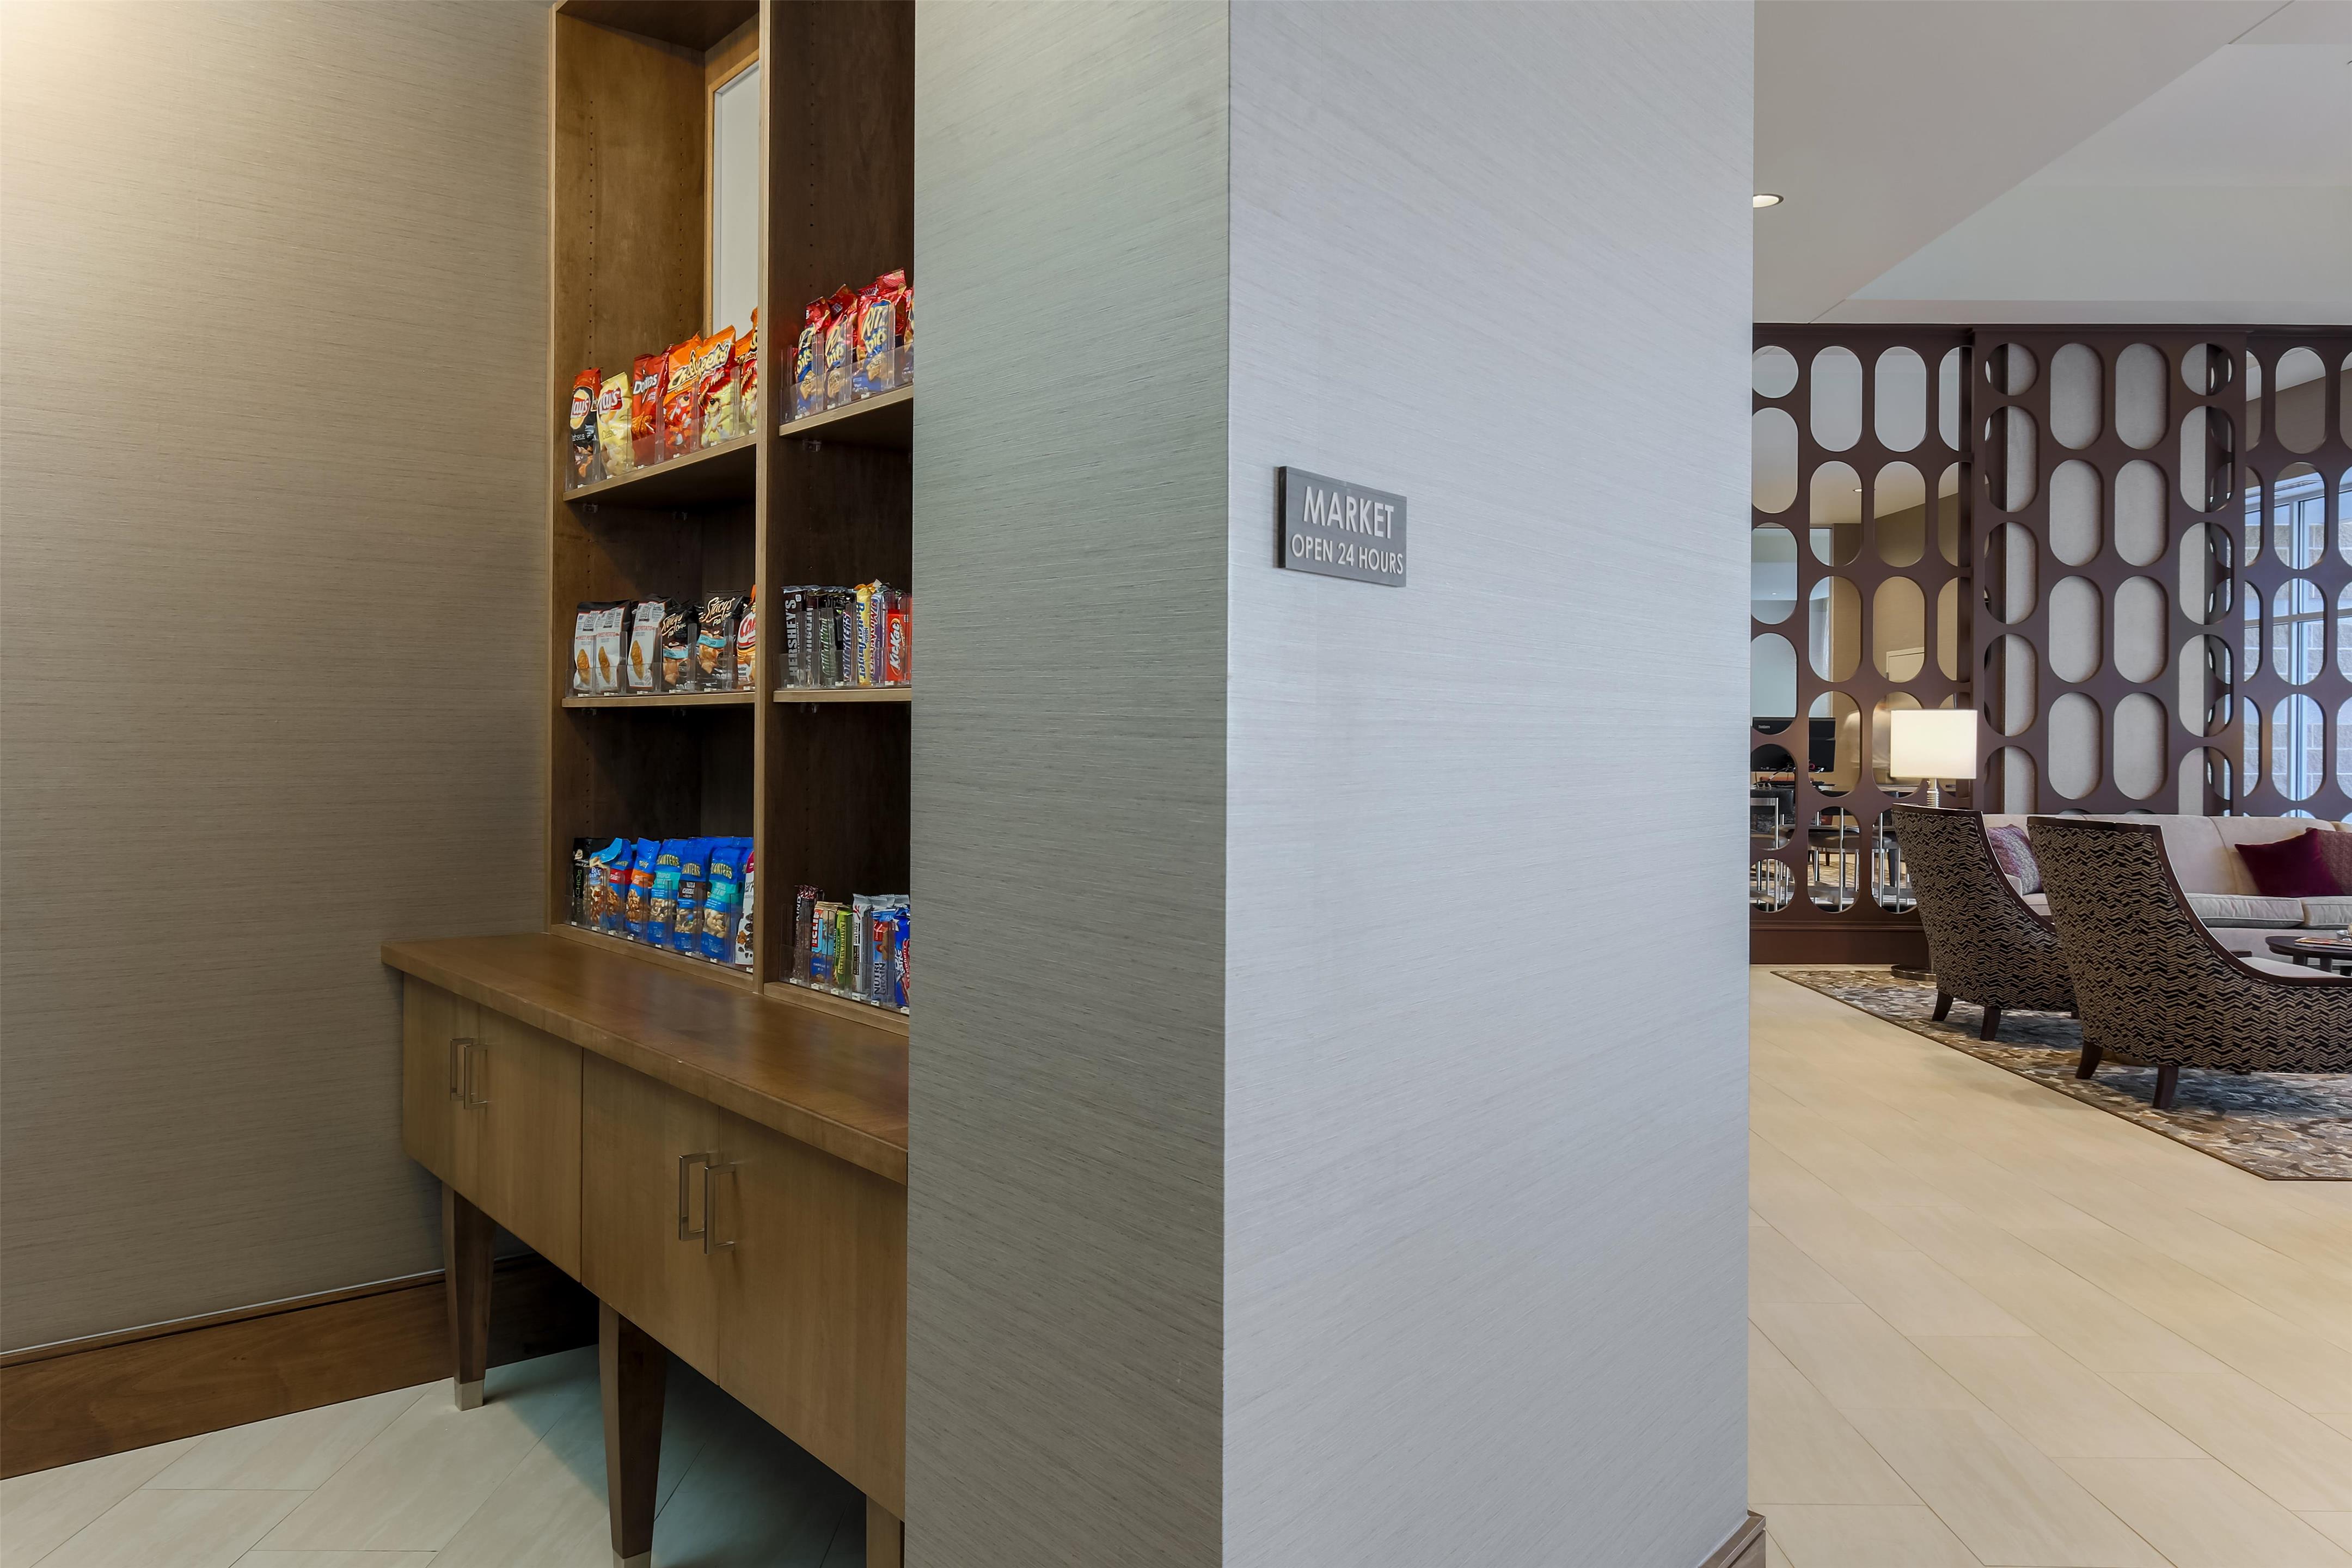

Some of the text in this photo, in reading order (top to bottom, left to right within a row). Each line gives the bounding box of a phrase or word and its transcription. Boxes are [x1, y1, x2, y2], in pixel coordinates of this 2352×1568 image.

[633, 373, 658, 394] Doritos
[570, 398, 589, 418] Lay's
[599, 390, 620, 415] Lay's
[1303, 486, 1394, 539] MARKET
[1291, 534, 1403, 575] OPEN 24 HOURS
[705, 597, 736, 623] Stacy's
[785, 599, 798, 676] HERSHEY'S
